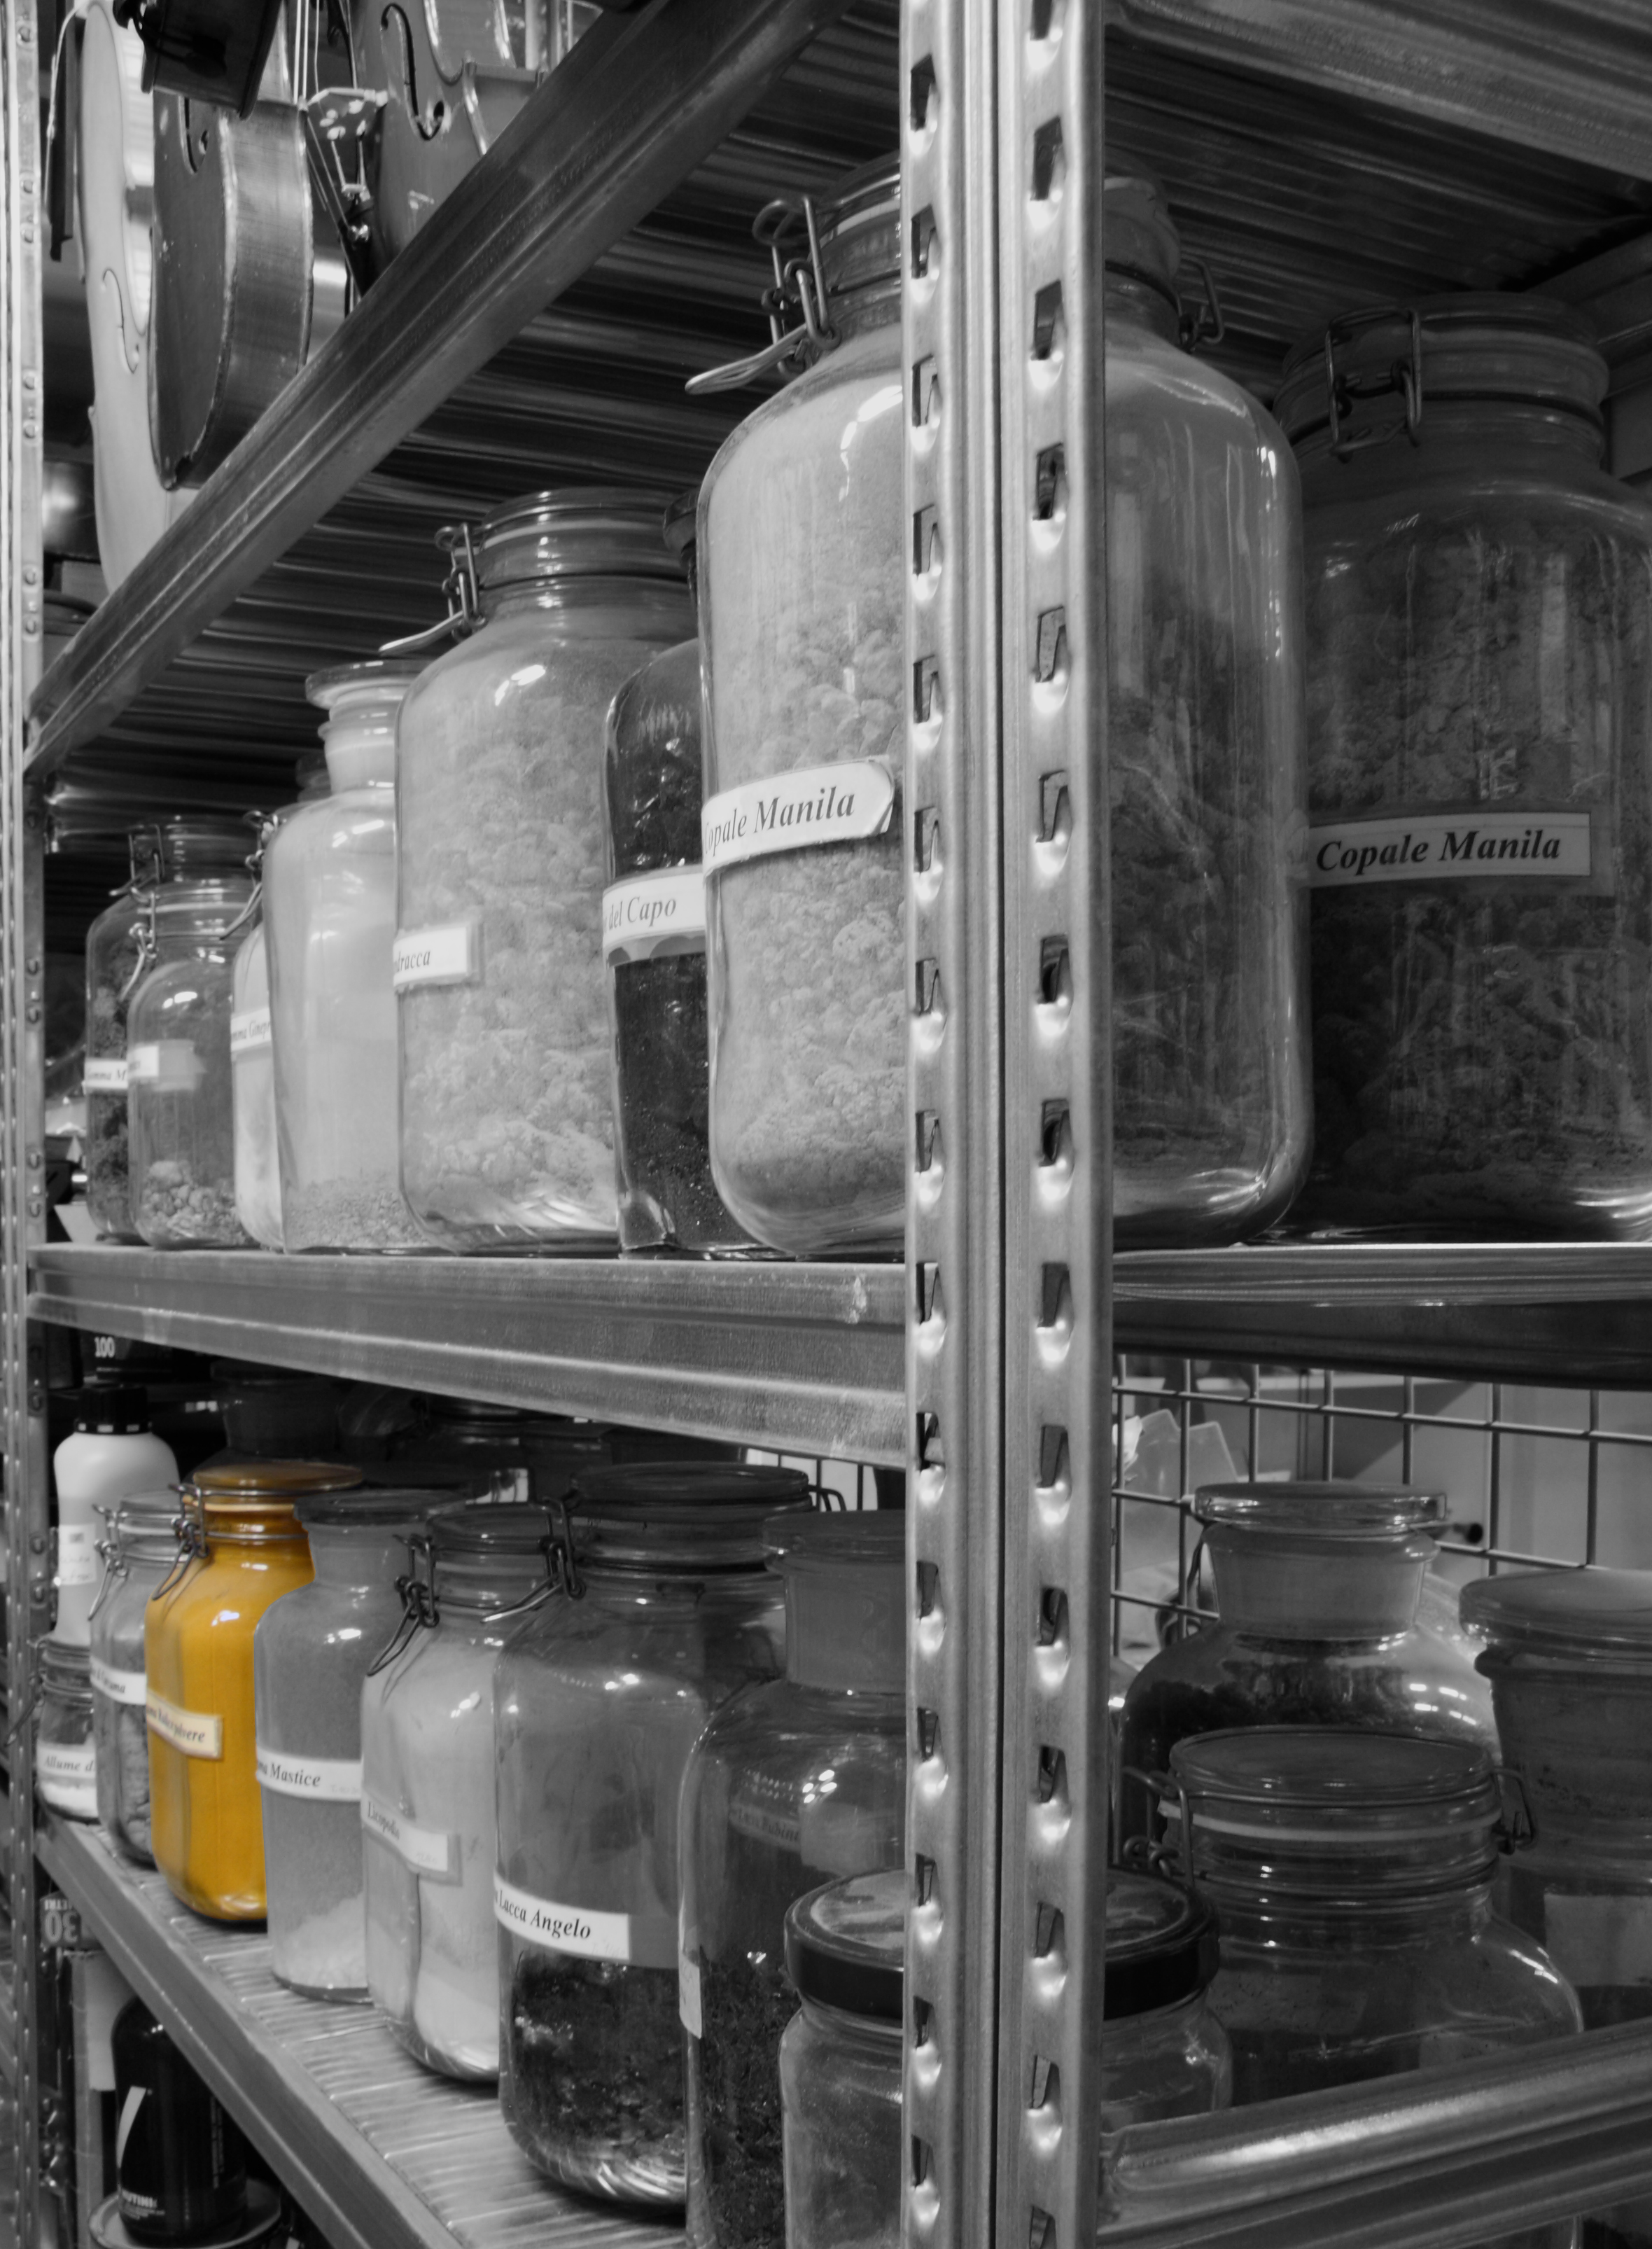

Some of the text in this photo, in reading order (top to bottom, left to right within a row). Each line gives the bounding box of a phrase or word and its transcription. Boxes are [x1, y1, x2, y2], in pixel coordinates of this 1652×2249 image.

[705, 786, 855, 857] Copale Manila
[1316, 829, 1561, 876] Copale Manila
[609, 901, 623, 931] del
[627, 896, 677, 927] Capo
[94, 1337, 115, 1358] 100
[44, 1755, 80, 1770] Allume
[270, 1762, 321, 1788] Mastice
[45, 1912, 78, 1943] 30
[499, 1890, 592, 1940] Lacca Angelo
